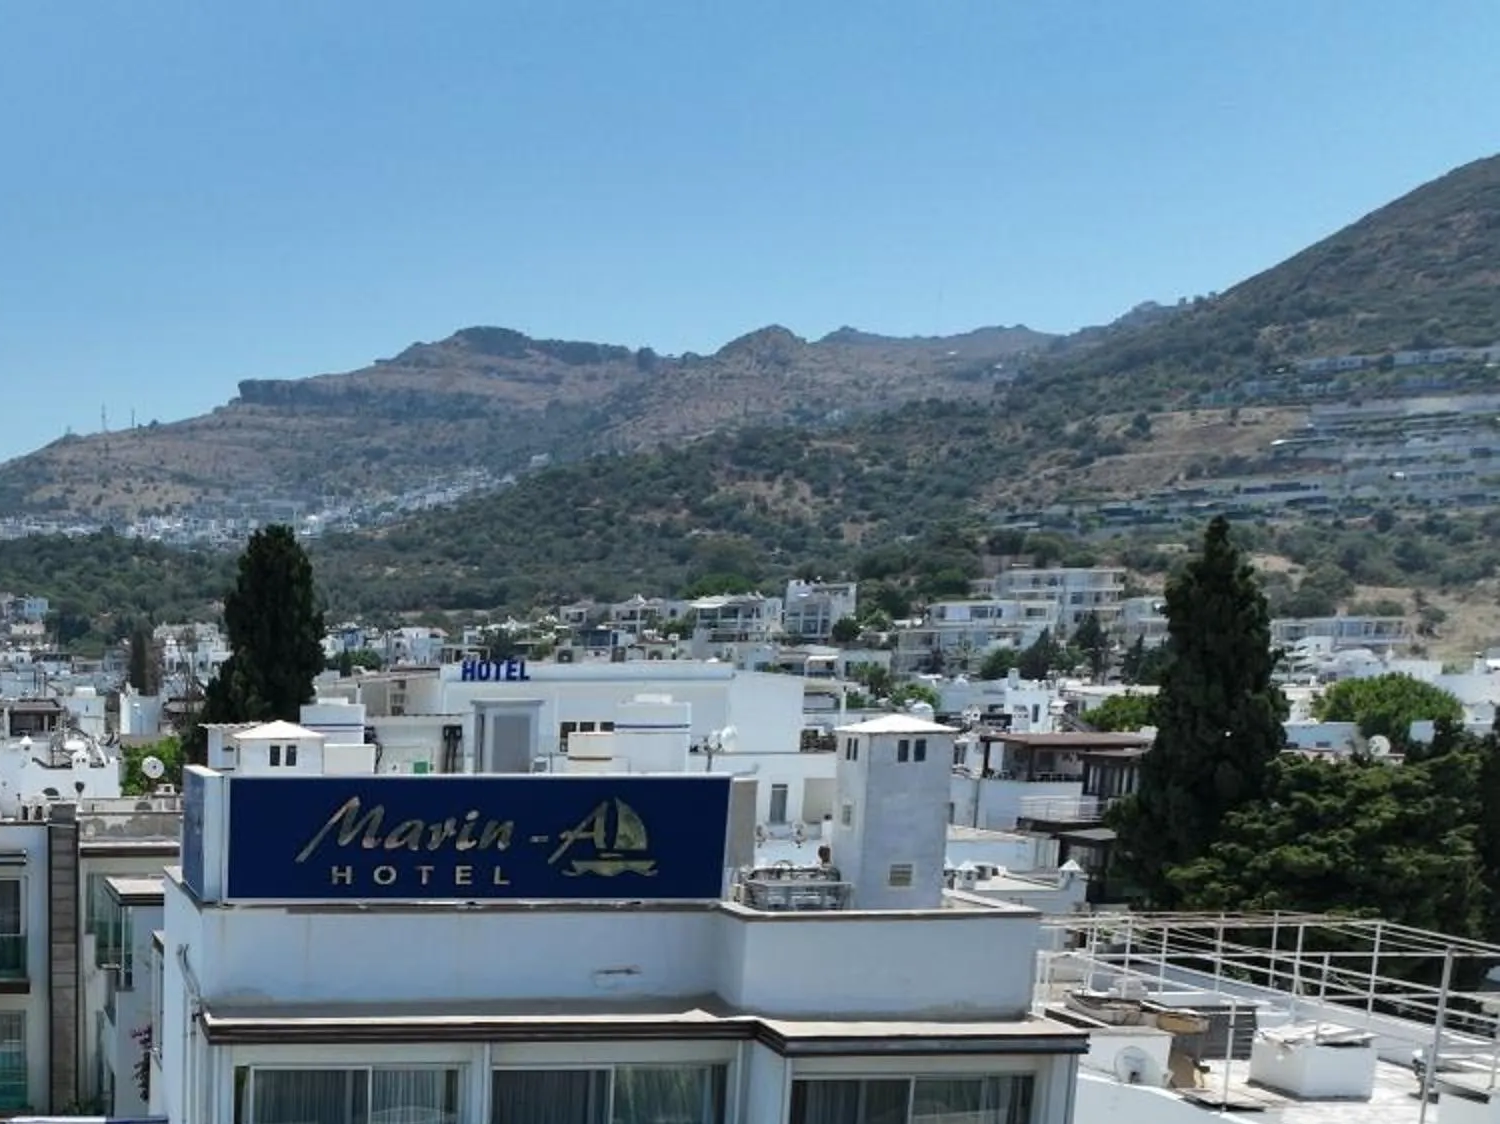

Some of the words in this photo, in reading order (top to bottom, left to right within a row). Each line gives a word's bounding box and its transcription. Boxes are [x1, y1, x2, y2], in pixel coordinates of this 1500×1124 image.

[461, 657, 531, 682] HOTEL
[295, 796, 515, 863] Marin
[330, 864, 512, 886] HOTEL
